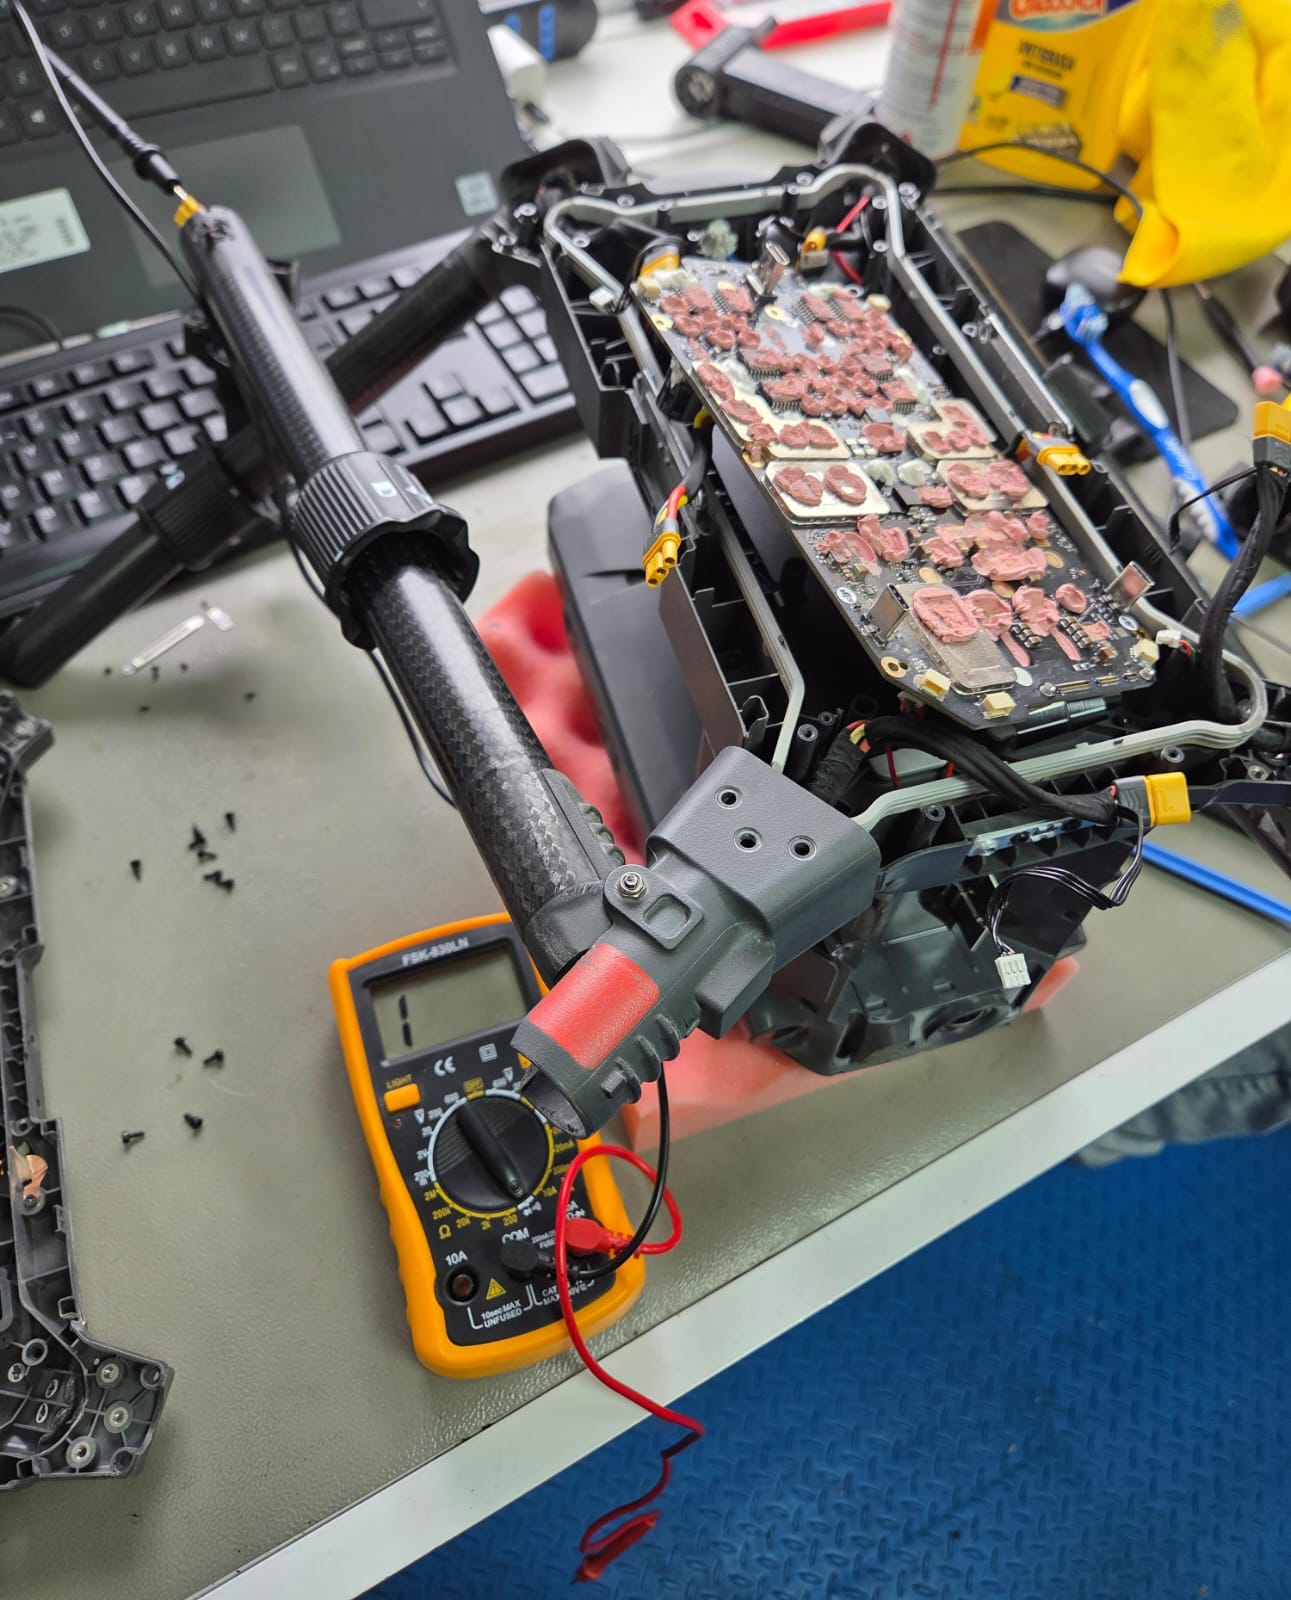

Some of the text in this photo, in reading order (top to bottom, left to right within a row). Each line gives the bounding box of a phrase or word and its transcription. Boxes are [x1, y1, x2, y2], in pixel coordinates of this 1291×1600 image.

[434, 1056, 456, 1077] CE
[386, 1073, 413, 1090] LIGHT
[444, 1250, 469, 1266] 10A
[501, 1299, 523, 1315] MAX
[483, 1307, 523, 1328] UNFUSED
